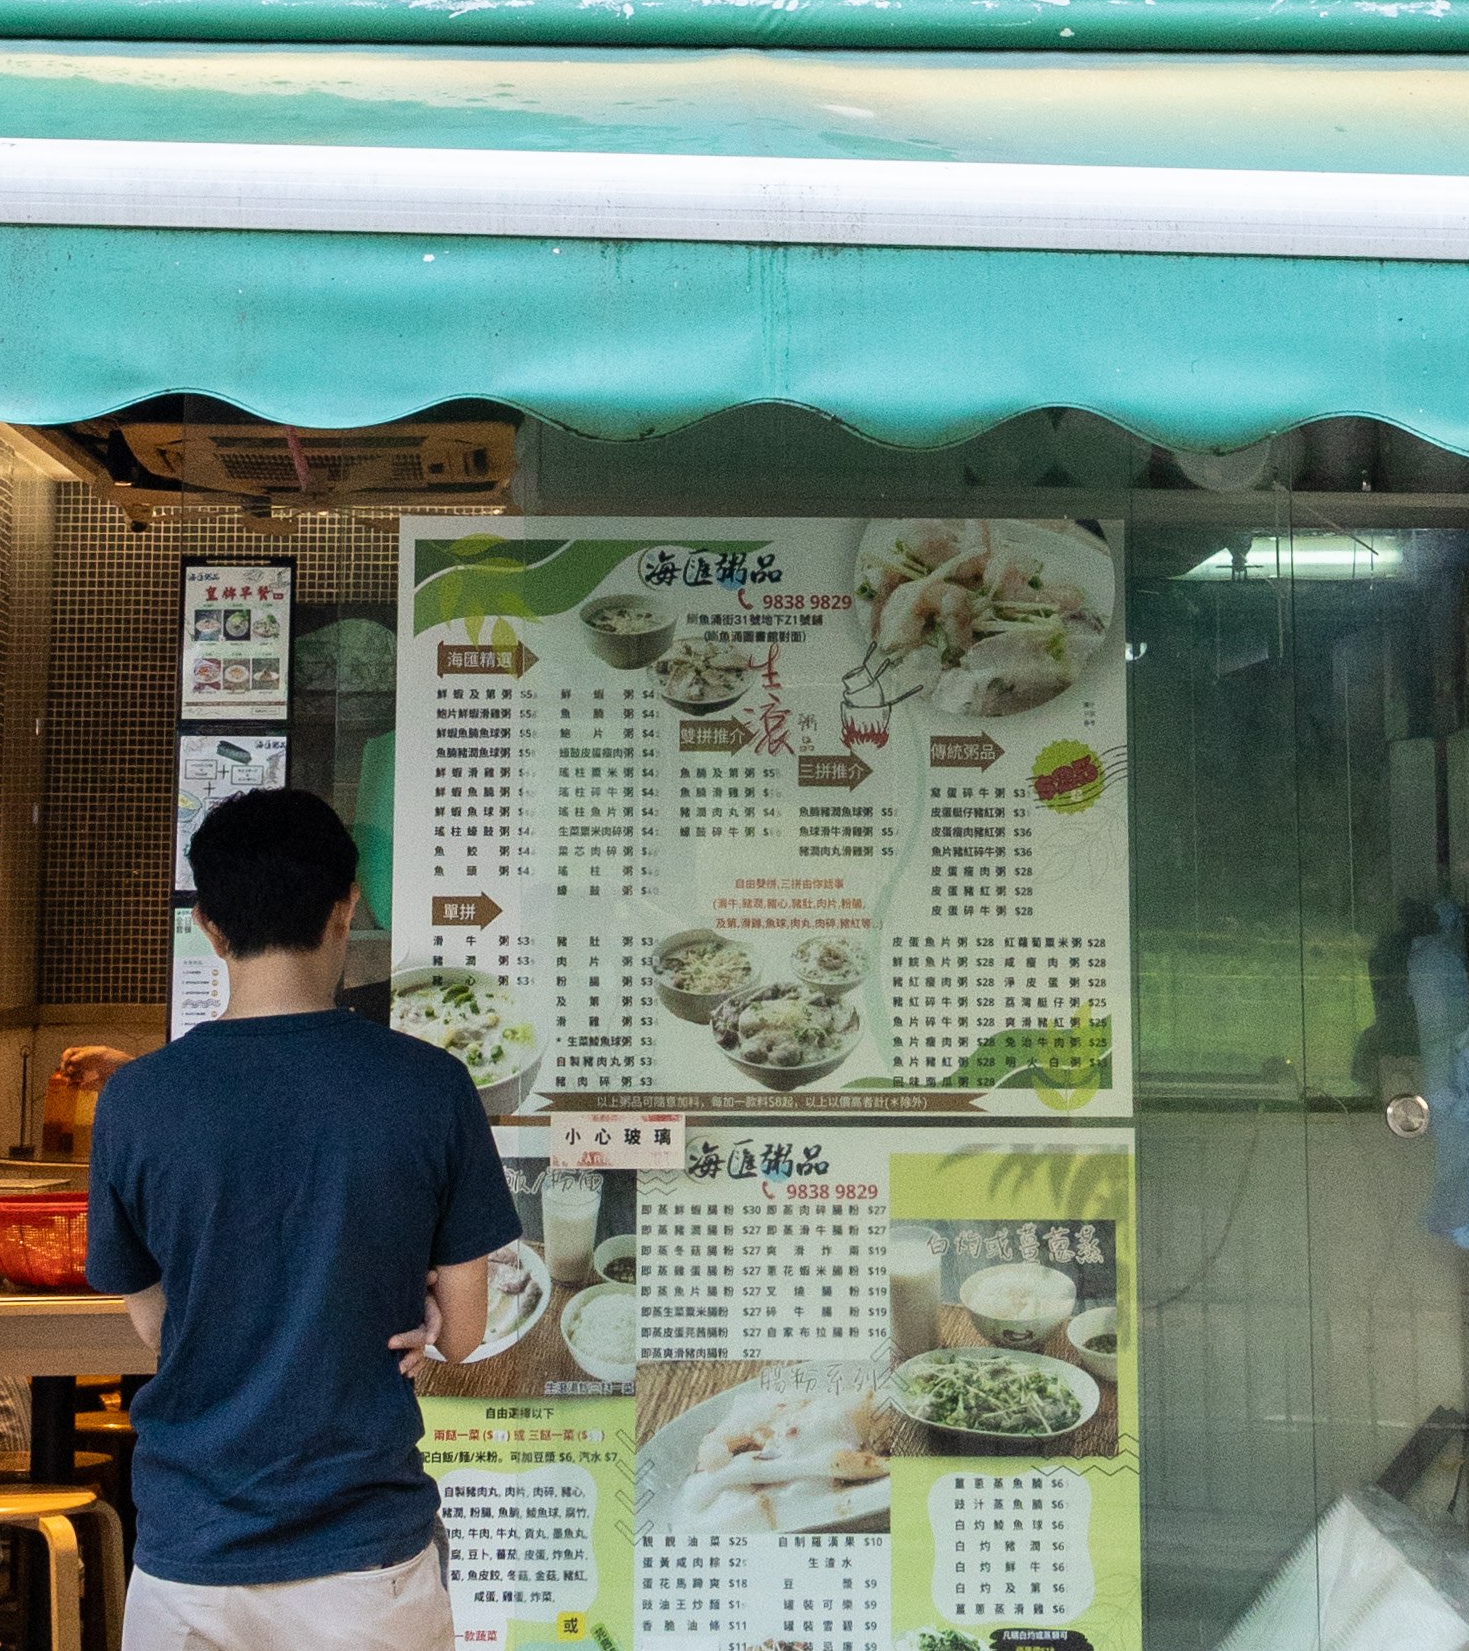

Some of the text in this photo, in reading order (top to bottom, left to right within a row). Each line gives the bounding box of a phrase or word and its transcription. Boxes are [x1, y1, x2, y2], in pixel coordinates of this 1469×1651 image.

[763, 595, 852, 610] 9838 9829
[447, 652, 512, 668] 海匯精選
[931, 744, 995, 760] 傳統粥品
[799, 764, 864, 779] 三拼推介
[1014, 828, 1032, 837] $36
[1014, 848, 1032, 857] $36
[932, 866, 1032, 876] 皮蛋瘦肉粥 $28
[932, 886, 1032, 896] 皮蛋豬紅粥 $28
[443, 903, 476, 920] 單拼
[932, 906, 1032, 916] 皮蛋碎牛粥 $28
[893, 937, 995, 947] 皮蛋魚片粥 $28
[1088, 938, 1106, 948] $28
[976, 958, 995, 967] $28
[1088, 959, 1106, 968] $28
[976, 978, 995, 988] $28
[1088, 979, 1106, 988] $28
[976, 998, 995, 1008] $28
[1089, 999, 1107, 1008] $25
[976, 1018, 995, 1028] $28
[976, 1038, 995, 1048] $28
[976, 1058, 995, 1068] $28
[565, 1128, 671, 1146] 小心玻璃
[688, 1138, 830, 1180] 海匯粥品
[786, 1185, 878, 1199] 9838 9829
[743, 1205, 761, 1215] $30
[868, 1205, 887, 1215] $27
[743, 1225, 761, 1235] $27
[868, 1225, 887, 1235] $27
[743, 1246, 761, 1256] $27
[868, 1246, 887, 1256] $19
[743, 1266, 761, 1276] $27
[868, 1266, 887, 1276] $19
[743, 1286, 761, 1296] $27
[868, 1286, 887, 1296] $19
[743, 1307, 761, 1317] $27
[868, 1307, 887, 1317] $19
[743, 1328, 761, 1338] $27
[868, 1328, 887, 1338] $16
[743, 1348, 761, 1358] $27
[579, 1451, 617, 1463] 汽水 $7
[729, 1537, 747, 1546] $25
[865, 1537, 882, 1546] $10
[729, 1579, 747, 1588] $18
[865, 1579, 877, 1588] $9
[865, 1600, 877, 1610] $9
[564, 1618, 578, 1633] 或
[729, 1621, 747, 1631] $11
[865, 1621, 877, 1631] $9
[865, 1643, 877, 1651] $9
